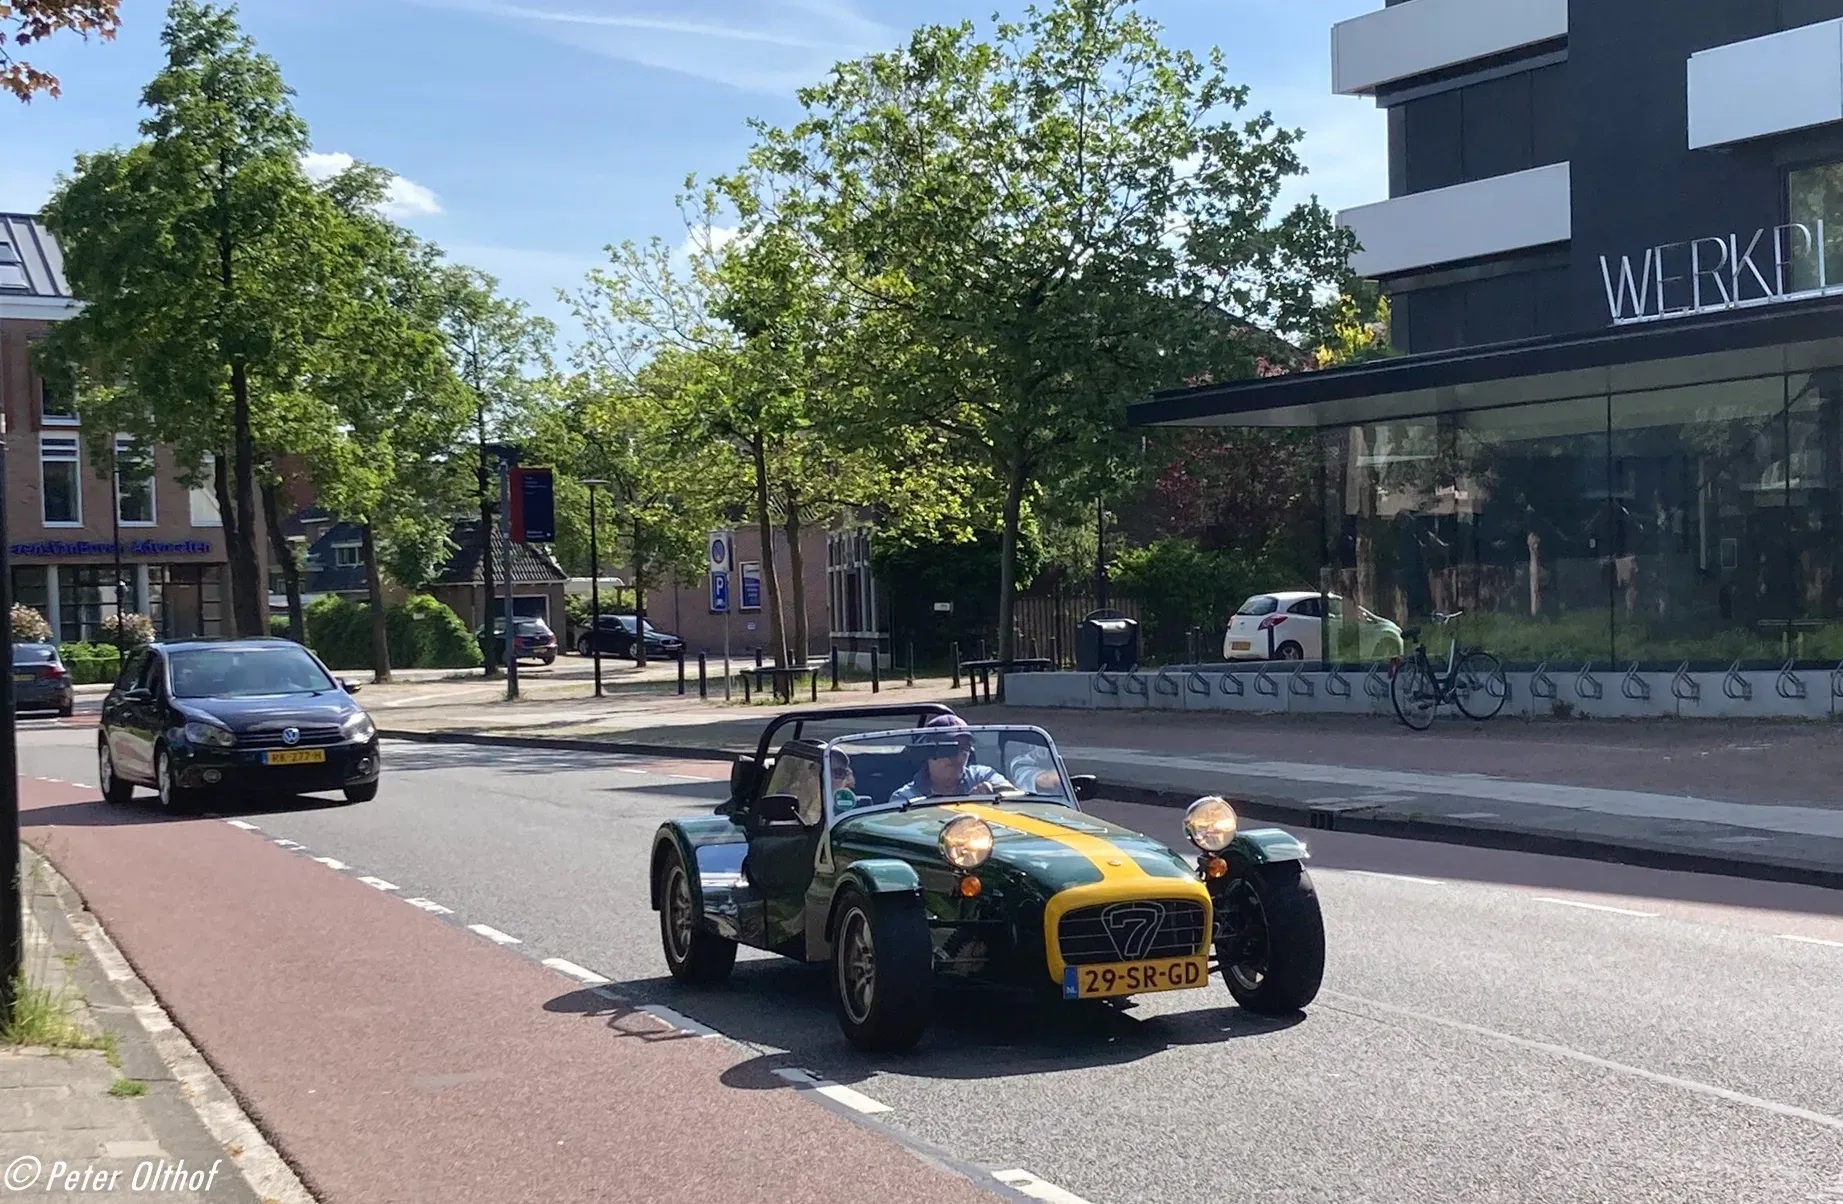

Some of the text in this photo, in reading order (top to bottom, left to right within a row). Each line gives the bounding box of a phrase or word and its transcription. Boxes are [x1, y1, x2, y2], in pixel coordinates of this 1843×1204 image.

[716, 576, 724, 596] P
[1110, 907, 1158, 957] 7
[1065, 985, 1077, 995] NL
[1084, 961, 1200, 994] 29-SR-GD
